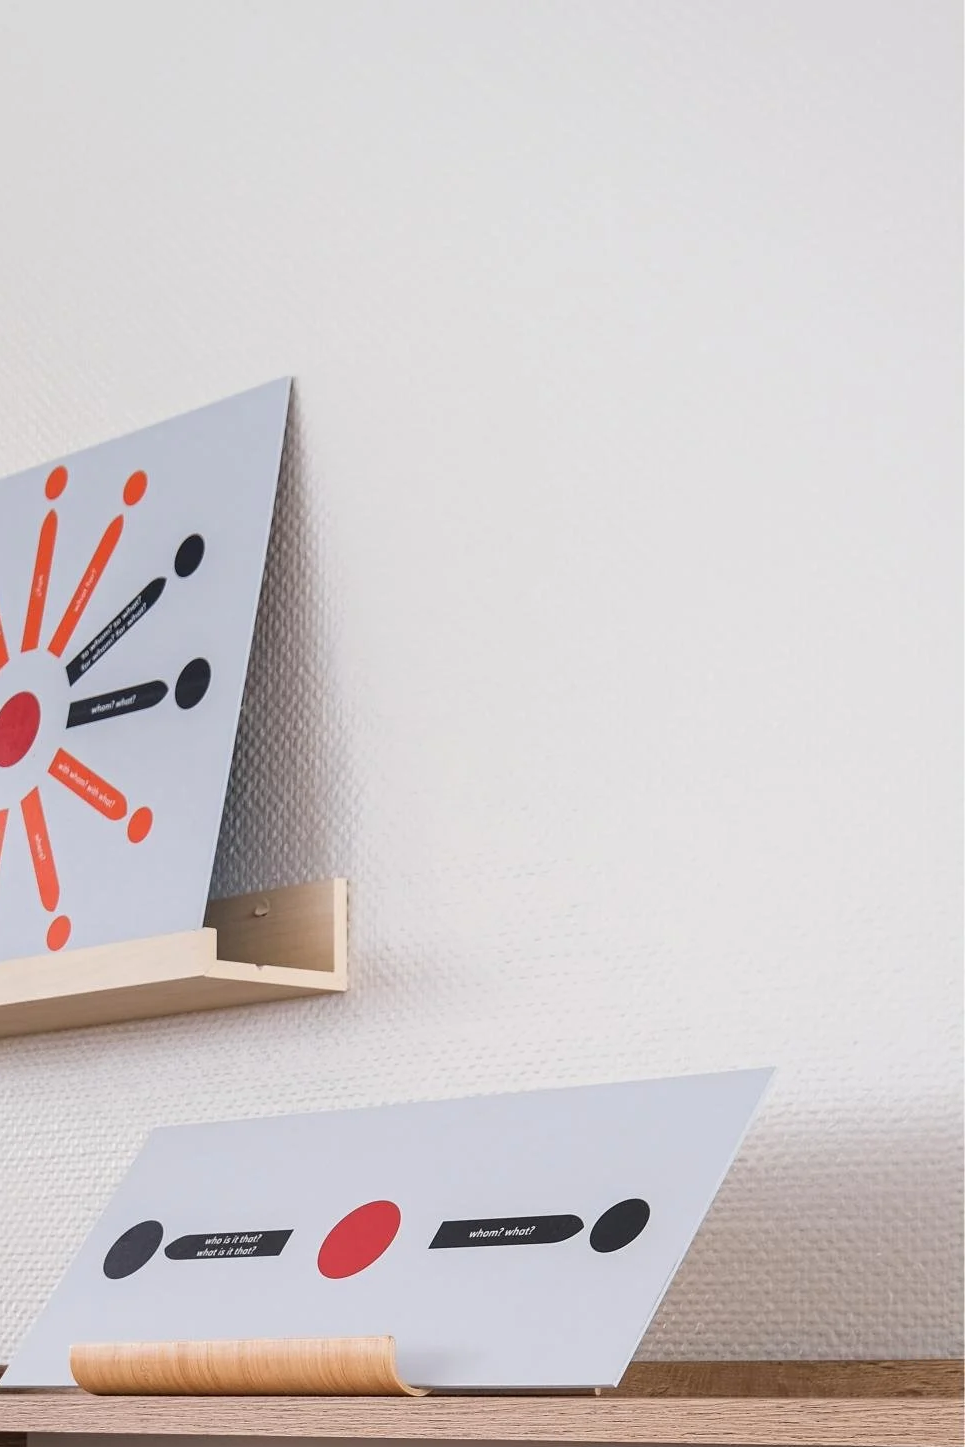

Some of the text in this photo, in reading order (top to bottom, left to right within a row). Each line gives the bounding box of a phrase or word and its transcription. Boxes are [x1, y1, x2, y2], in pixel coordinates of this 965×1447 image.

[89, 623, 113, 652] whom?
[122, 595, 142, 620] what?
[92, 635, 115, 662] whom?
[115, 626, 126, 639] for
[127, 602, 147, 627] what?
[91, 694, 137, 714] whom? what?
[69, 771, 89, 788] whom?
[99, 793, 116, 808] what?
[205, 1233, 263, 1245] who is it that?
[469, 1226, 536, 1239] whom? what?
[196, 1246, 257, 1257] what is it that?
